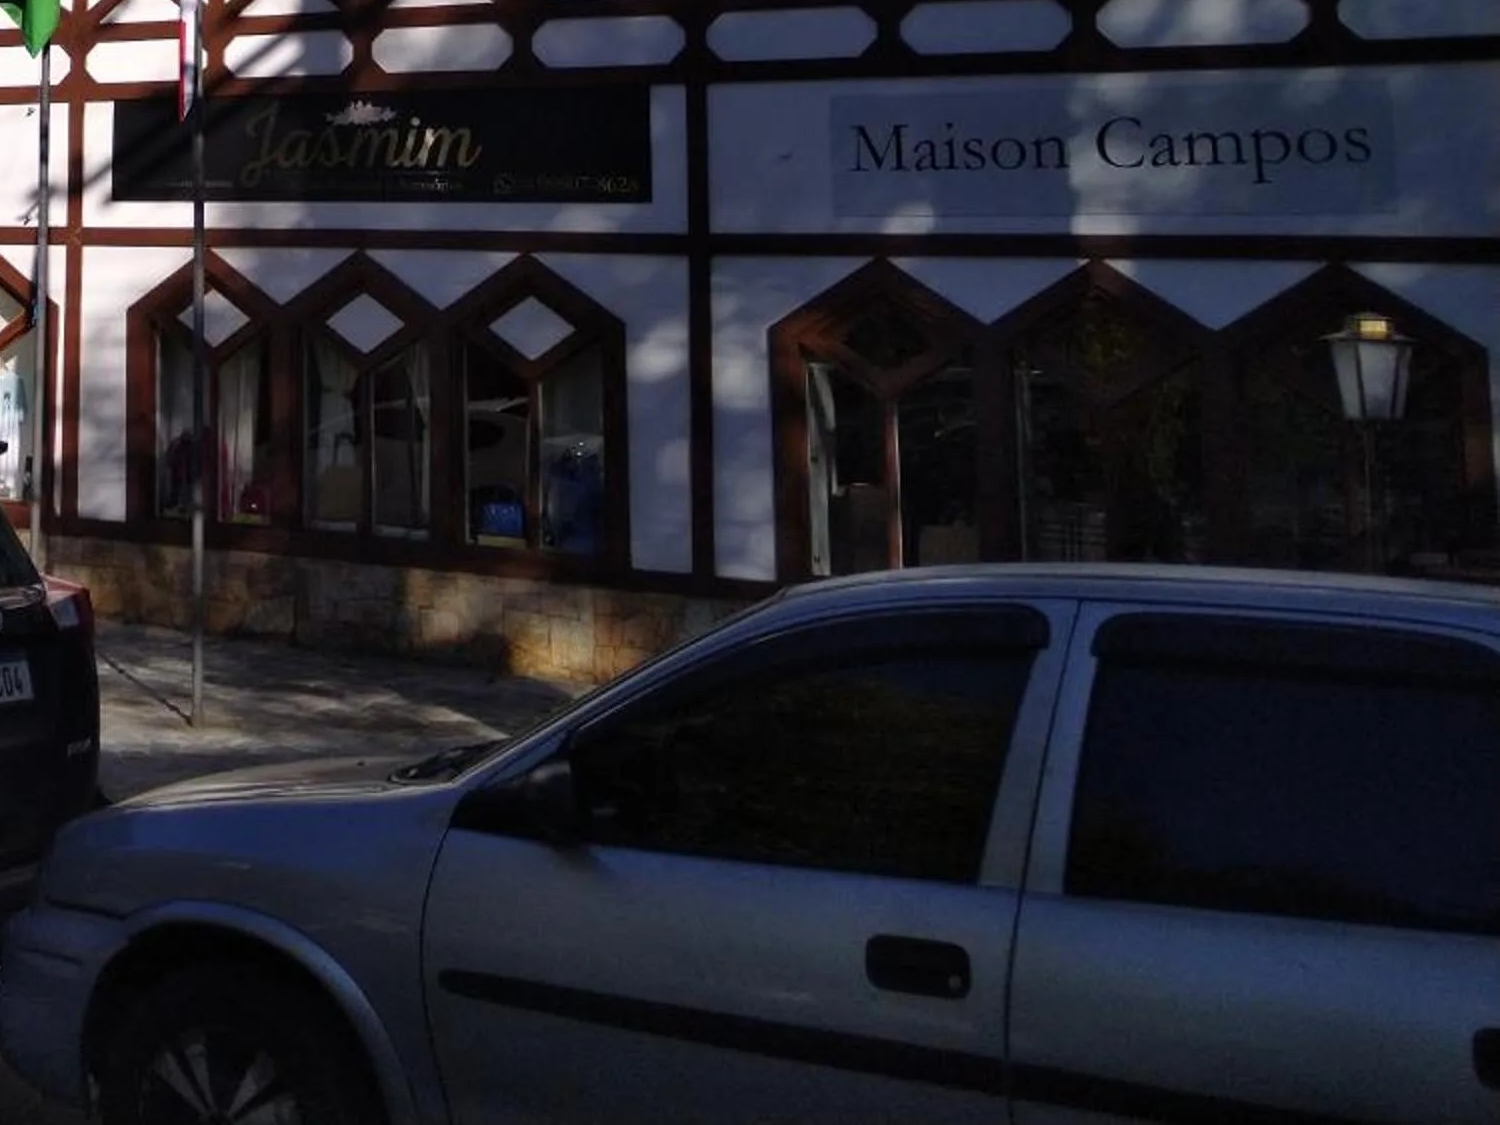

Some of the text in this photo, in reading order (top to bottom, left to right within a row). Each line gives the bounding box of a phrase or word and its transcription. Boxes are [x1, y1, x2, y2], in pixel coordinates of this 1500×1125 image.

[242, 101, 482, 185] Jasmim
[851, 117, 1372, 183] Maison Campos
